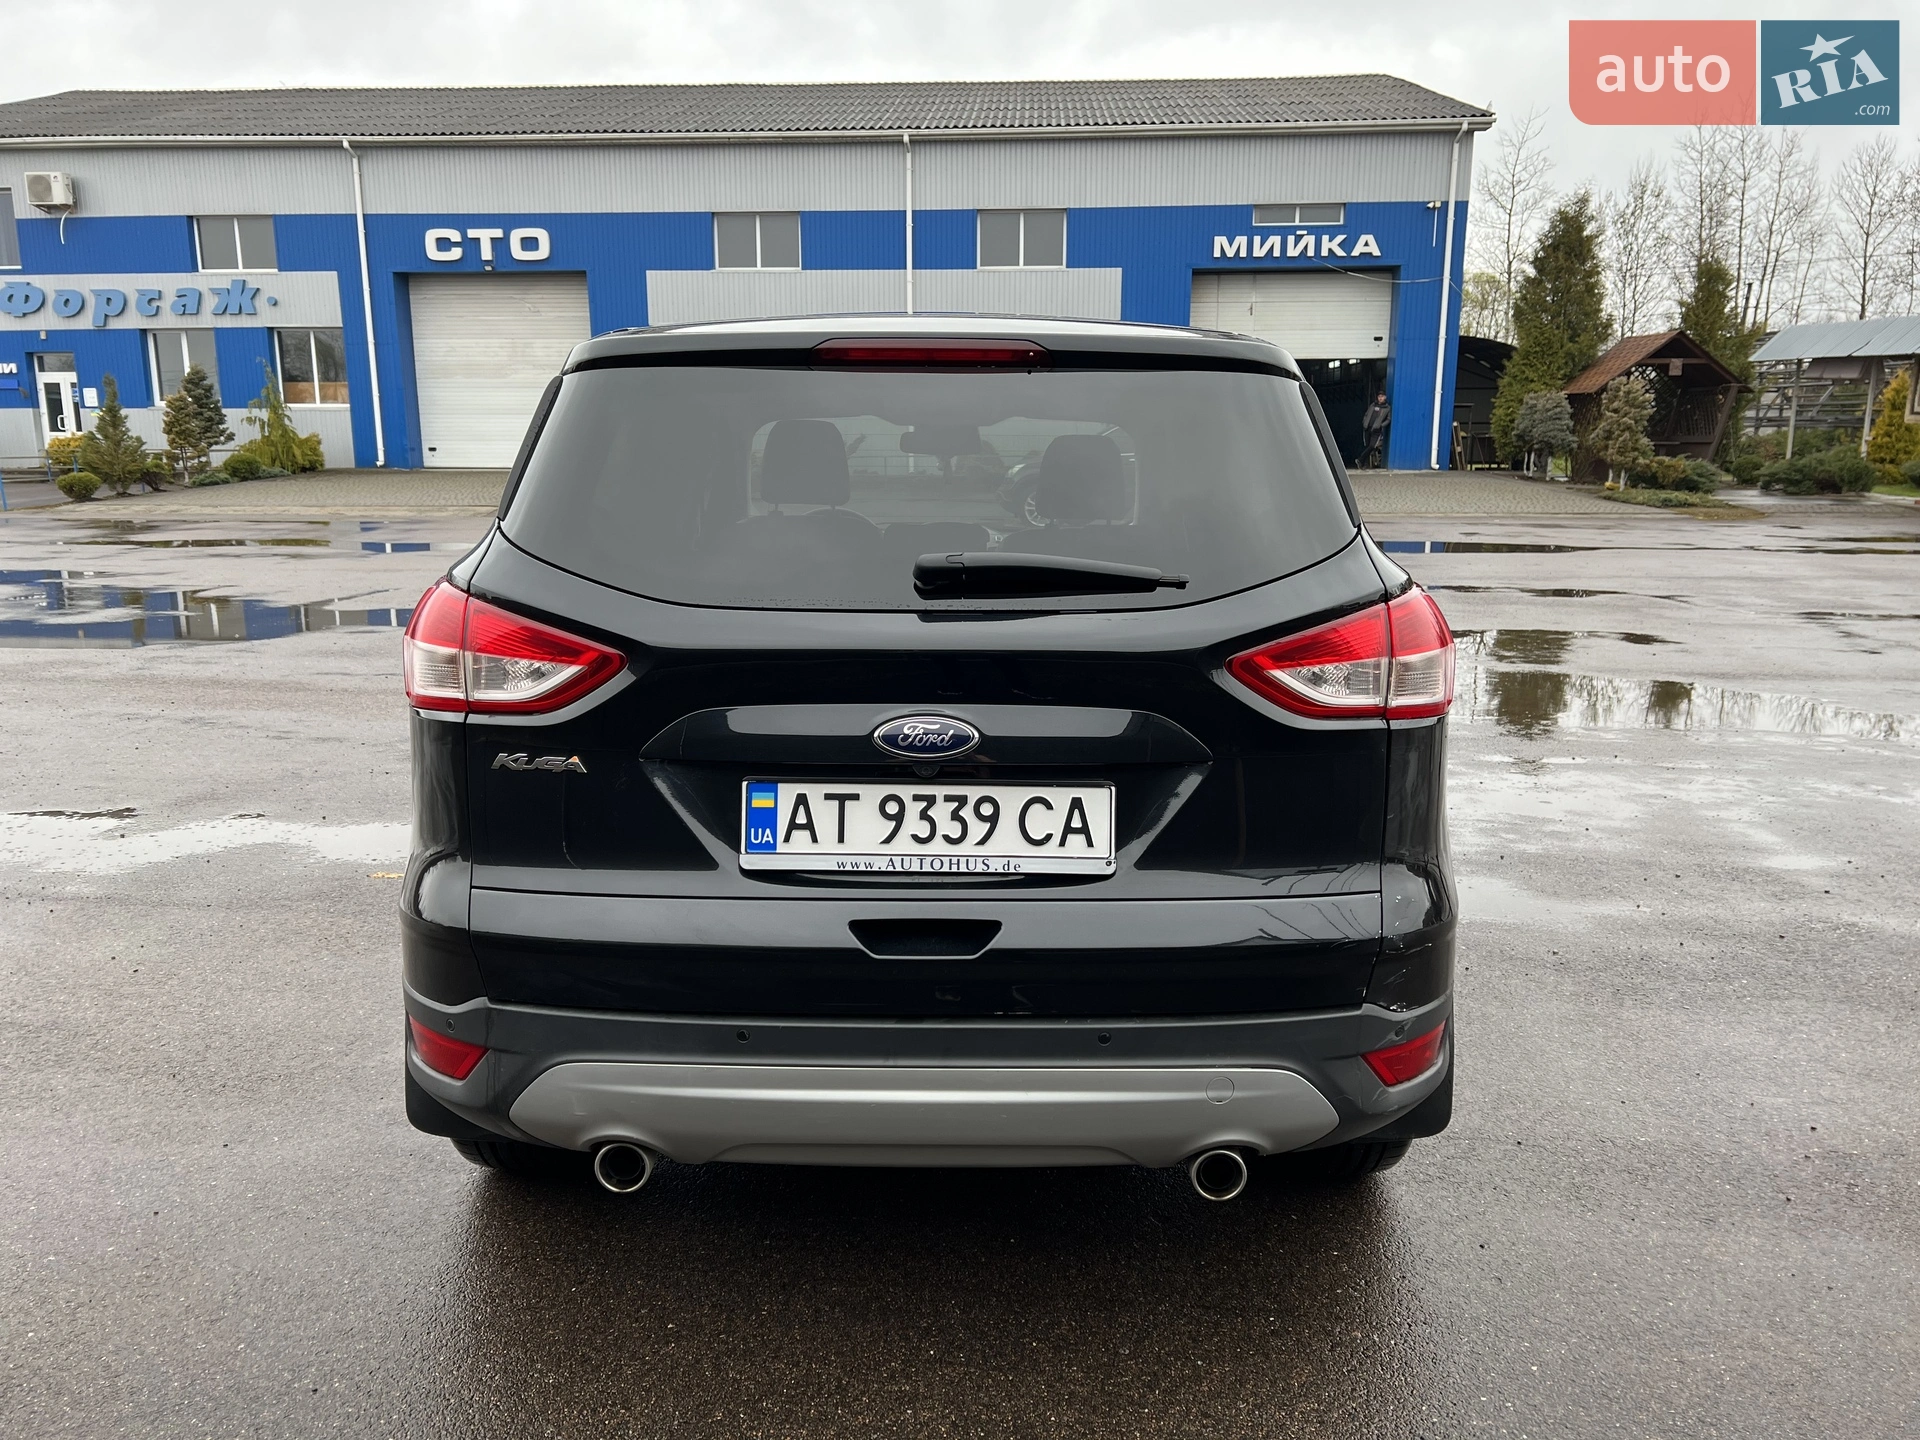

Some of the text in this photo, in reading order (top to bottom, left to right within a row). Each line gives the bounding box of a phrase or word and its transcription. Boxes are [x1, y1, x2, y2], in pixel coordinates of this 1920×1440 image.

[424, 227, 551, 261] СТО
[1212, 230, 1382, 258] МИЙКА
[897, 722, 955, 748] Ford
[491, 753, 588, 773] KUGA
[782, 792, 1095, 848] AT 9339 CA
[750, 828, 774, 845] UA
[836, 857, 1021, 872] www.AUTOHUS.de
